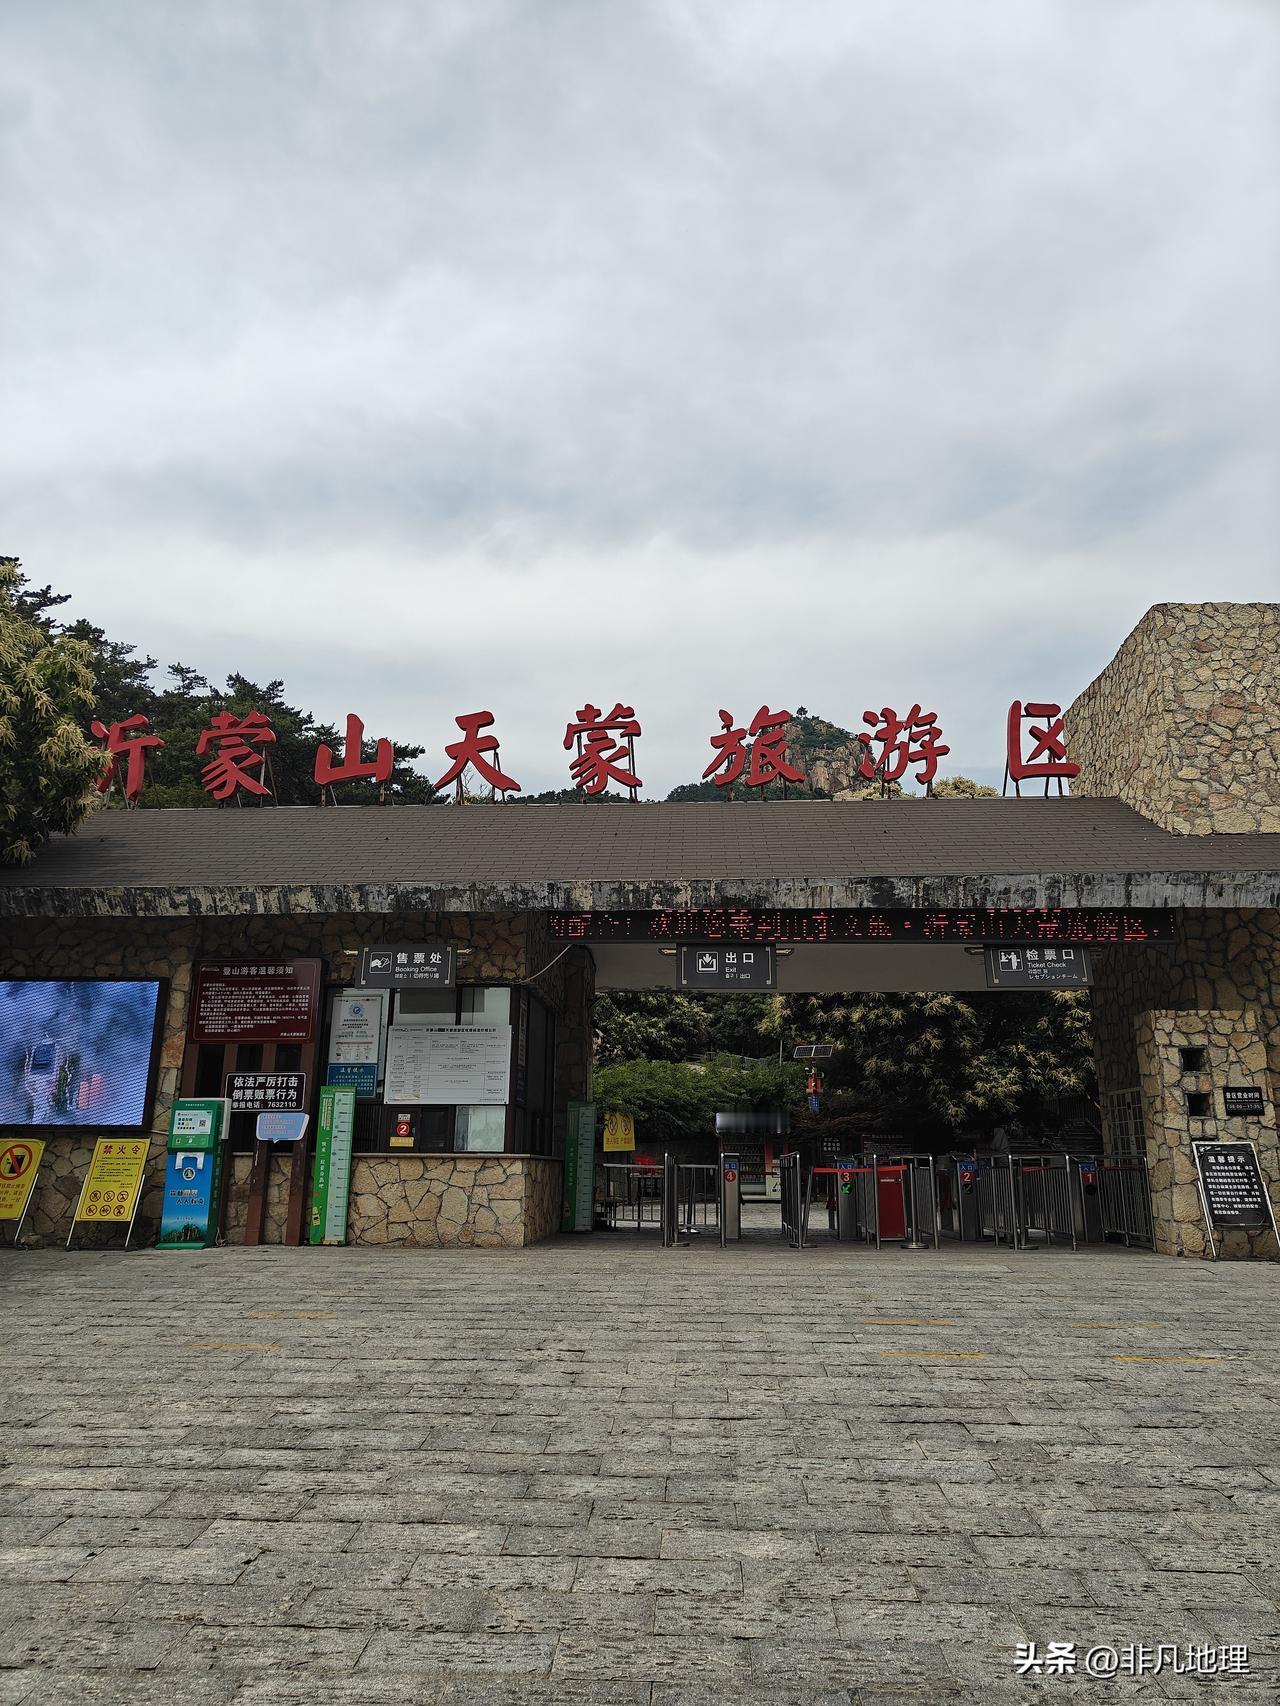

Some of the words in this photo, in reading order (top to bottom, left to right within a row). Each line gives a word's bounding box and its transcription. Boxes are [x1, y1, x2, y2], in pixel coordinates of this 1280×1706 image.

[91, 700, 1081, 799] 沂蒙山天蒙旅游区
[396, 952, 442, 964] 售票处
[725, 951, 754, 963] 出口
[1026, 949, 1074, 960] 检票口
[223, 966, 294, 975] 登山游客温馨须知
[233, 1076, 299, 1087] 依法严厉打击
[232, 1089, 297, 1100] 倒票贩票行为
[399, 1125, 407, 1134] 2
[103, 1144, 141, 1155] 禁火令
[1207, 1155, 1246, 1163] 温馨提示
[726, 1171, 733, 1181] 4
[843, 1172, 850, 1181] 3
[963, 1172, 971, 1182] 2
